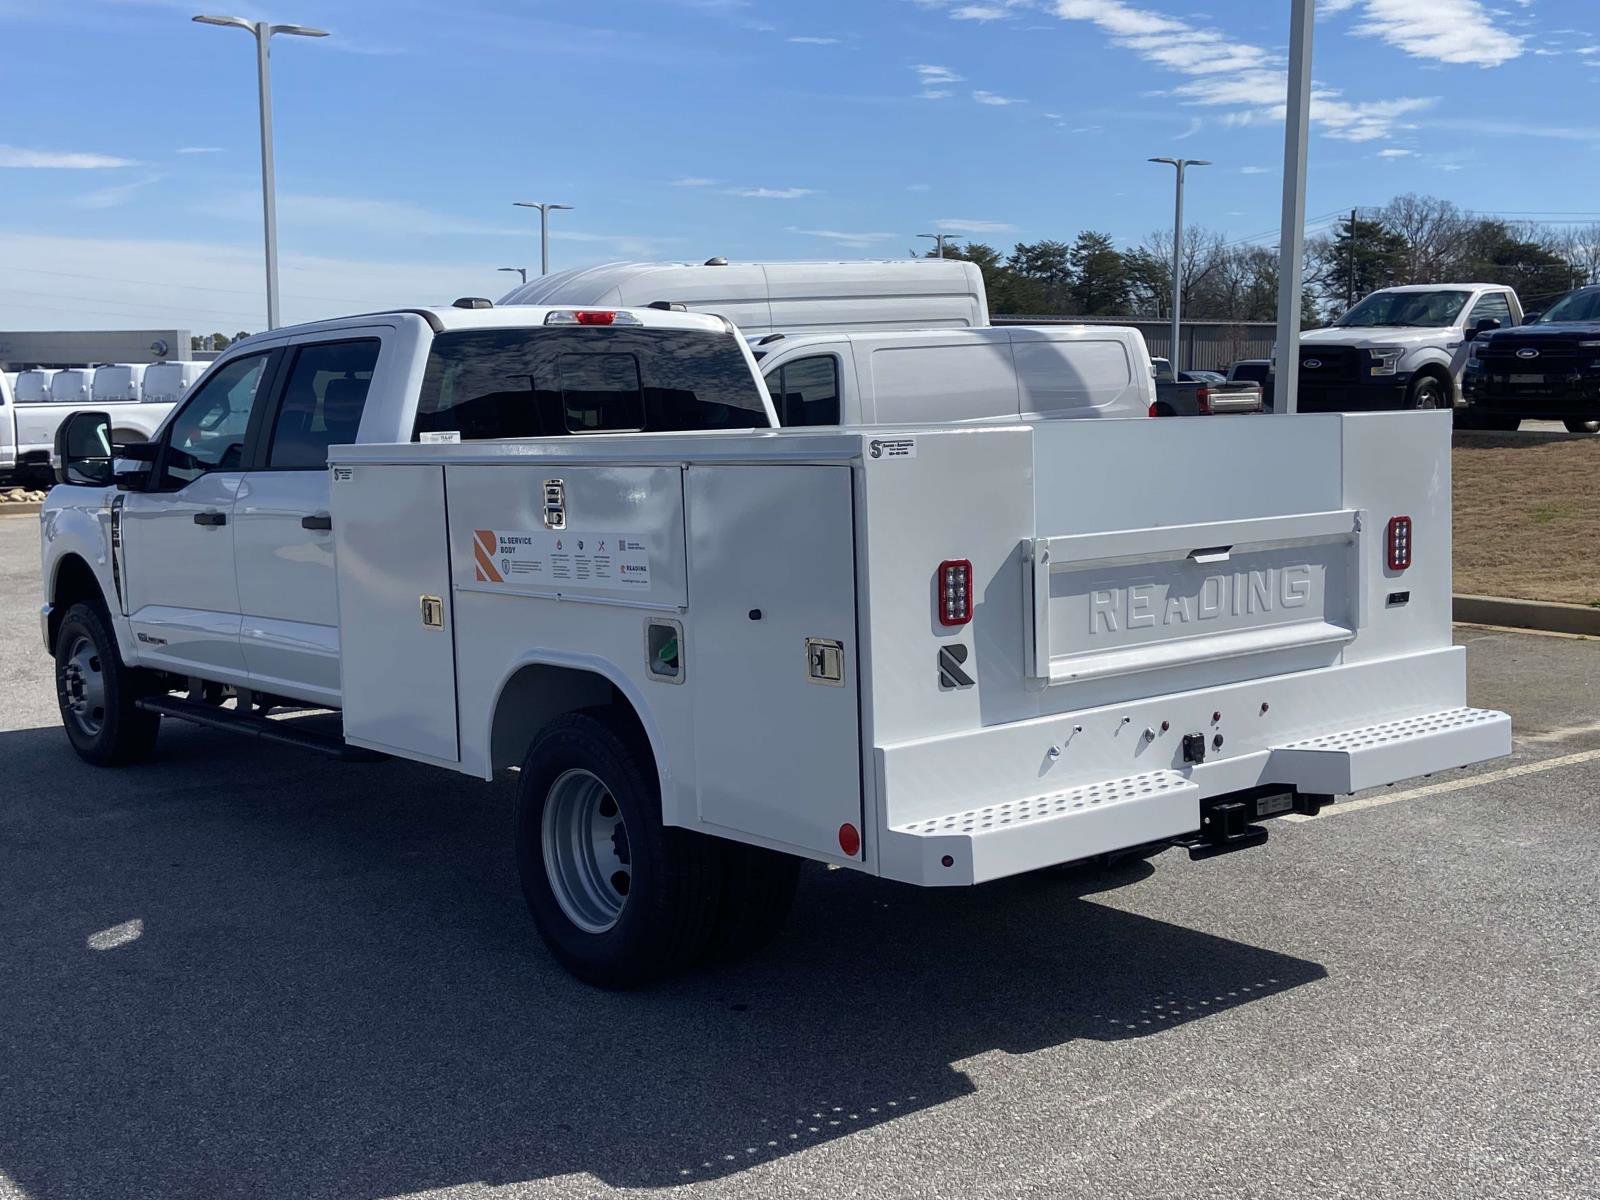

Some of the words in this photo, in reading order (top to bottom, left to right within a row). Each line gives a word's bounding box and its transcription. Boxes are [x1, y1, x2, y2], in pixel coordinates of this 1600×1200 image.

[508, 537, 532, 545] SERVICE
[500, 546, 516, 554] BODY
[1089, 565, 1312, 635] READING
